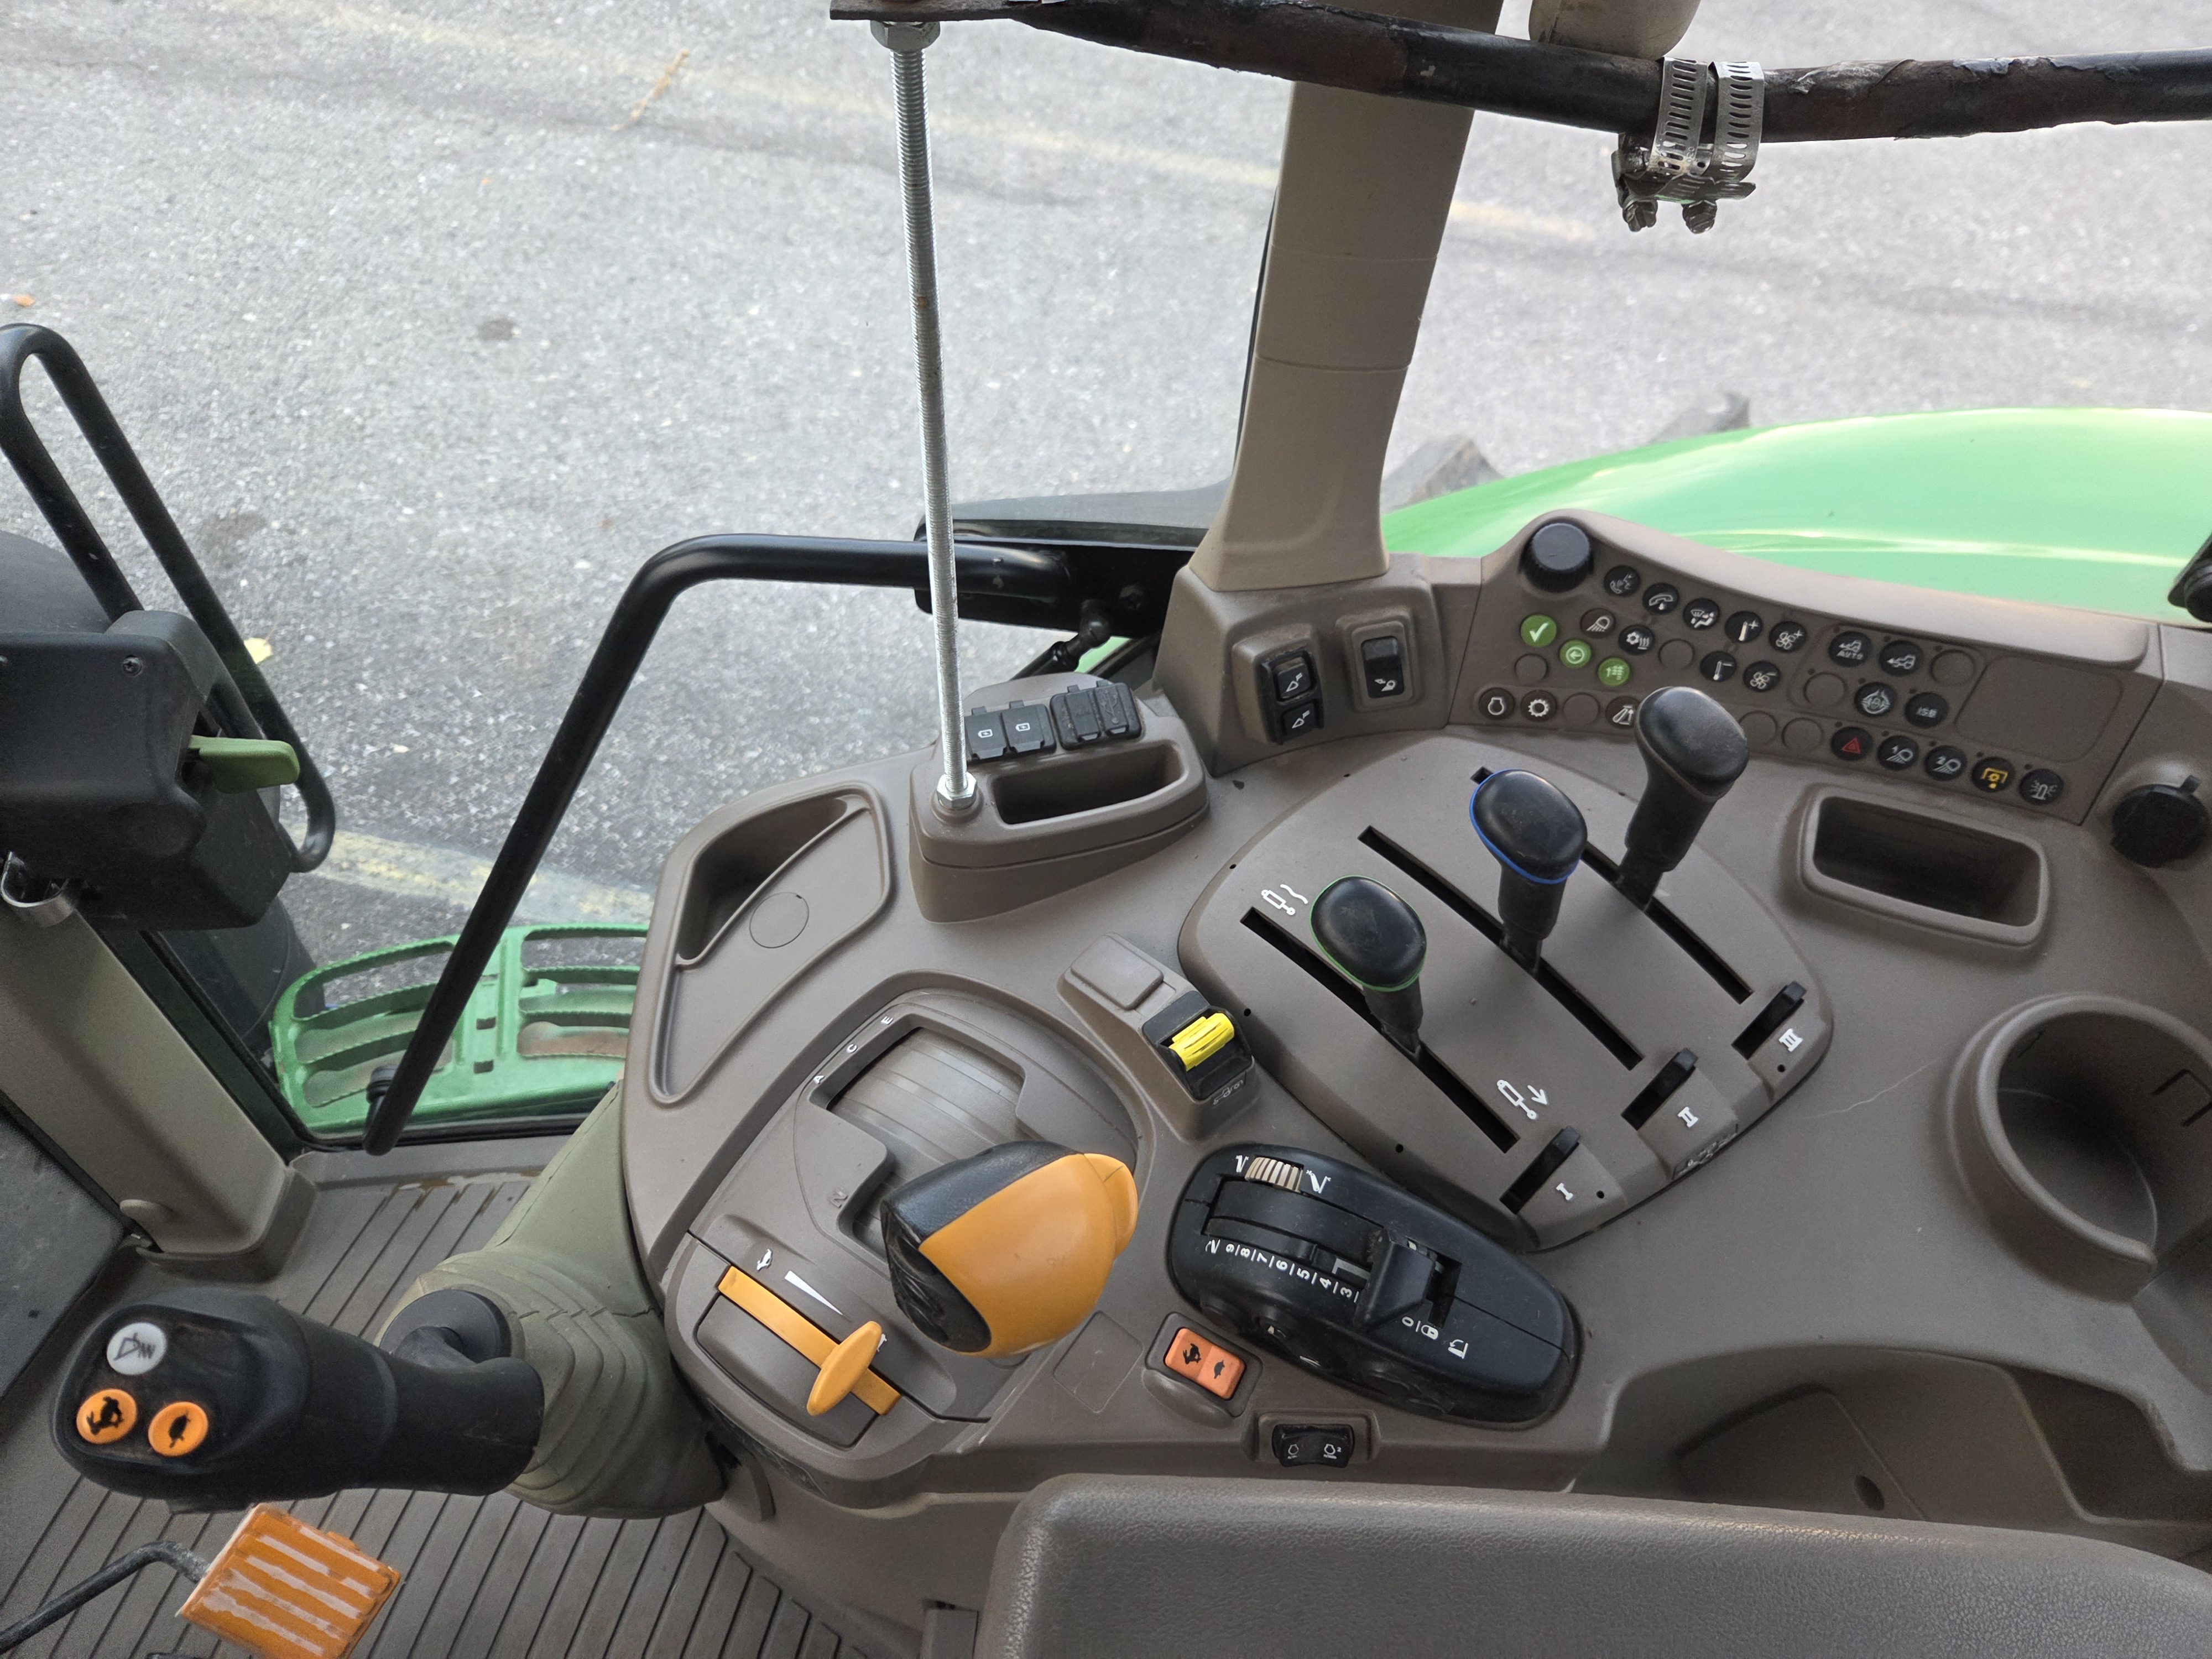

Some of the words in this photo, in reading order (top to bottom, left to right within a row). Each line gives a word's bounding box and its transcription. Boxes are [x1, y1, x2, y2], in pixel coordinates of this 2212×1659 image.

[881, 1016, 893, 1025] E
[1778, 1029, 1803, 1052] III
[847, 1044, 857, 1053] C
[813, 1075, 825, 1084] A
[1677, 1107, 1698, 1128] II
[1556, 1183, 1573, 1201] I
[1225, 1244, 1235, 1253] 9
[1240, 1248, 1250, 1258] 8
[1256, 1253, 1267, 1263] 7
[1276, 1260, 1288, 1271] 6
[1296, 1267, 1310, 1280] 5
[1319, 1277, 1332, 1289] 4
[1340, 1287, 1352, 1298] 3
[1401, 1316, 1414, 1327] 0
